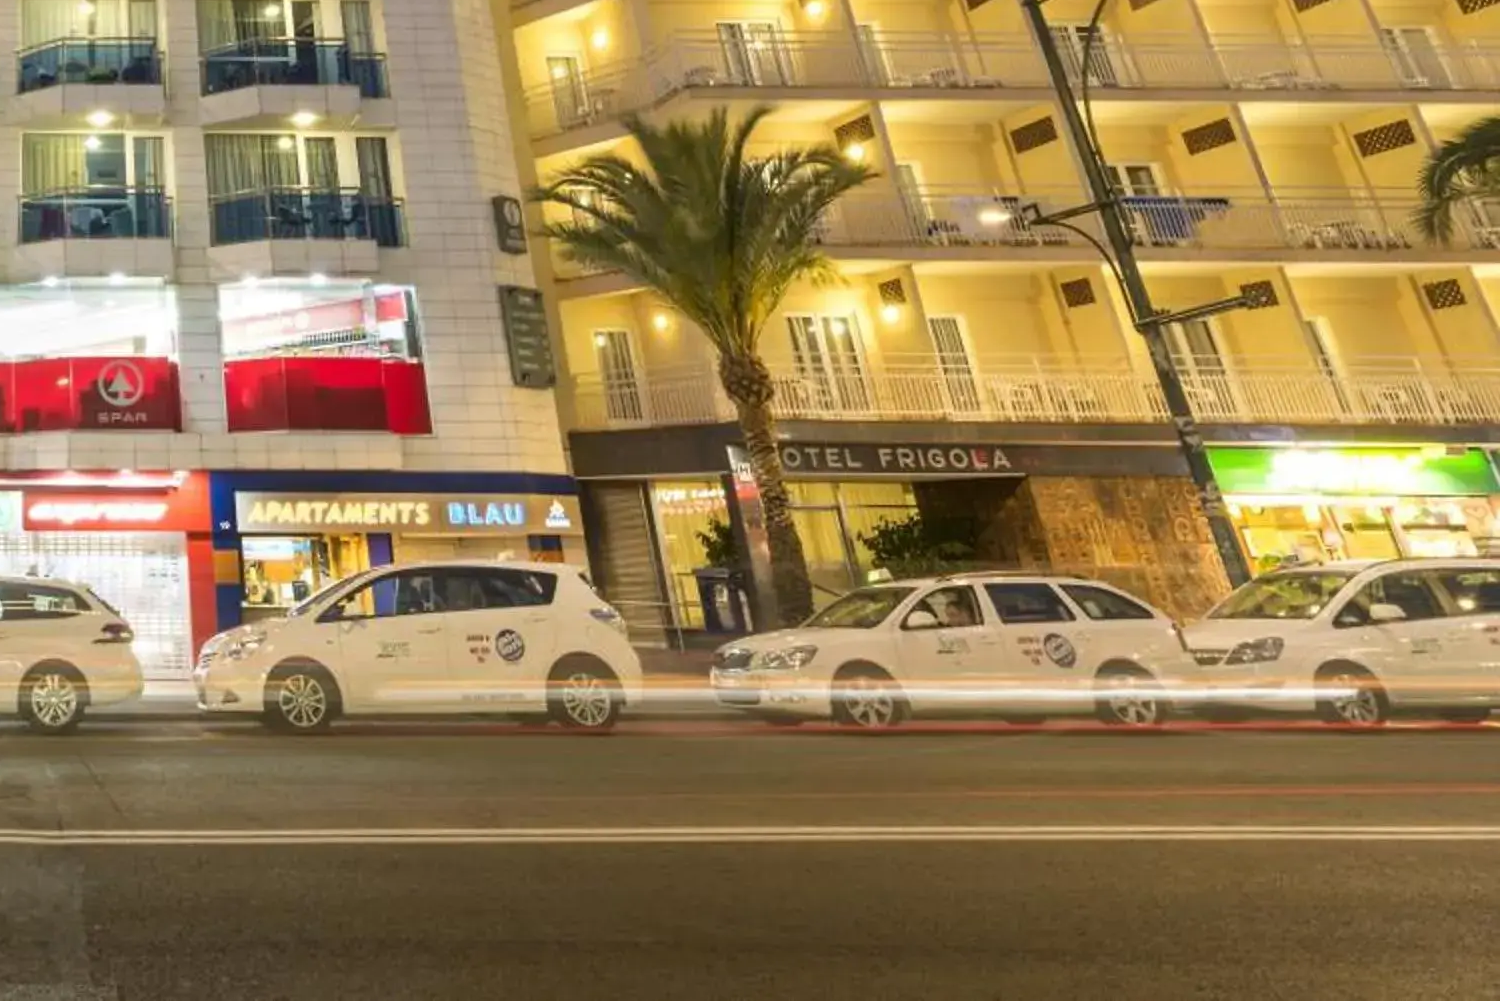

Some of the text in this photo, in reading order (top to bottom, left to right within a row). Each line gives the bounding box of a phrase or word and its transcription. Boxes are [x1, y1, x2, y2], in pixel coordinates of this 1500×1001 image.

[98, 411, 148, 424] SPAR
[783, 447, 1012, 470] OTEL FRIGOLA
[247, 501, 430, 525] APARTAMENTS
[448, 501, 525, 525] BLAU
